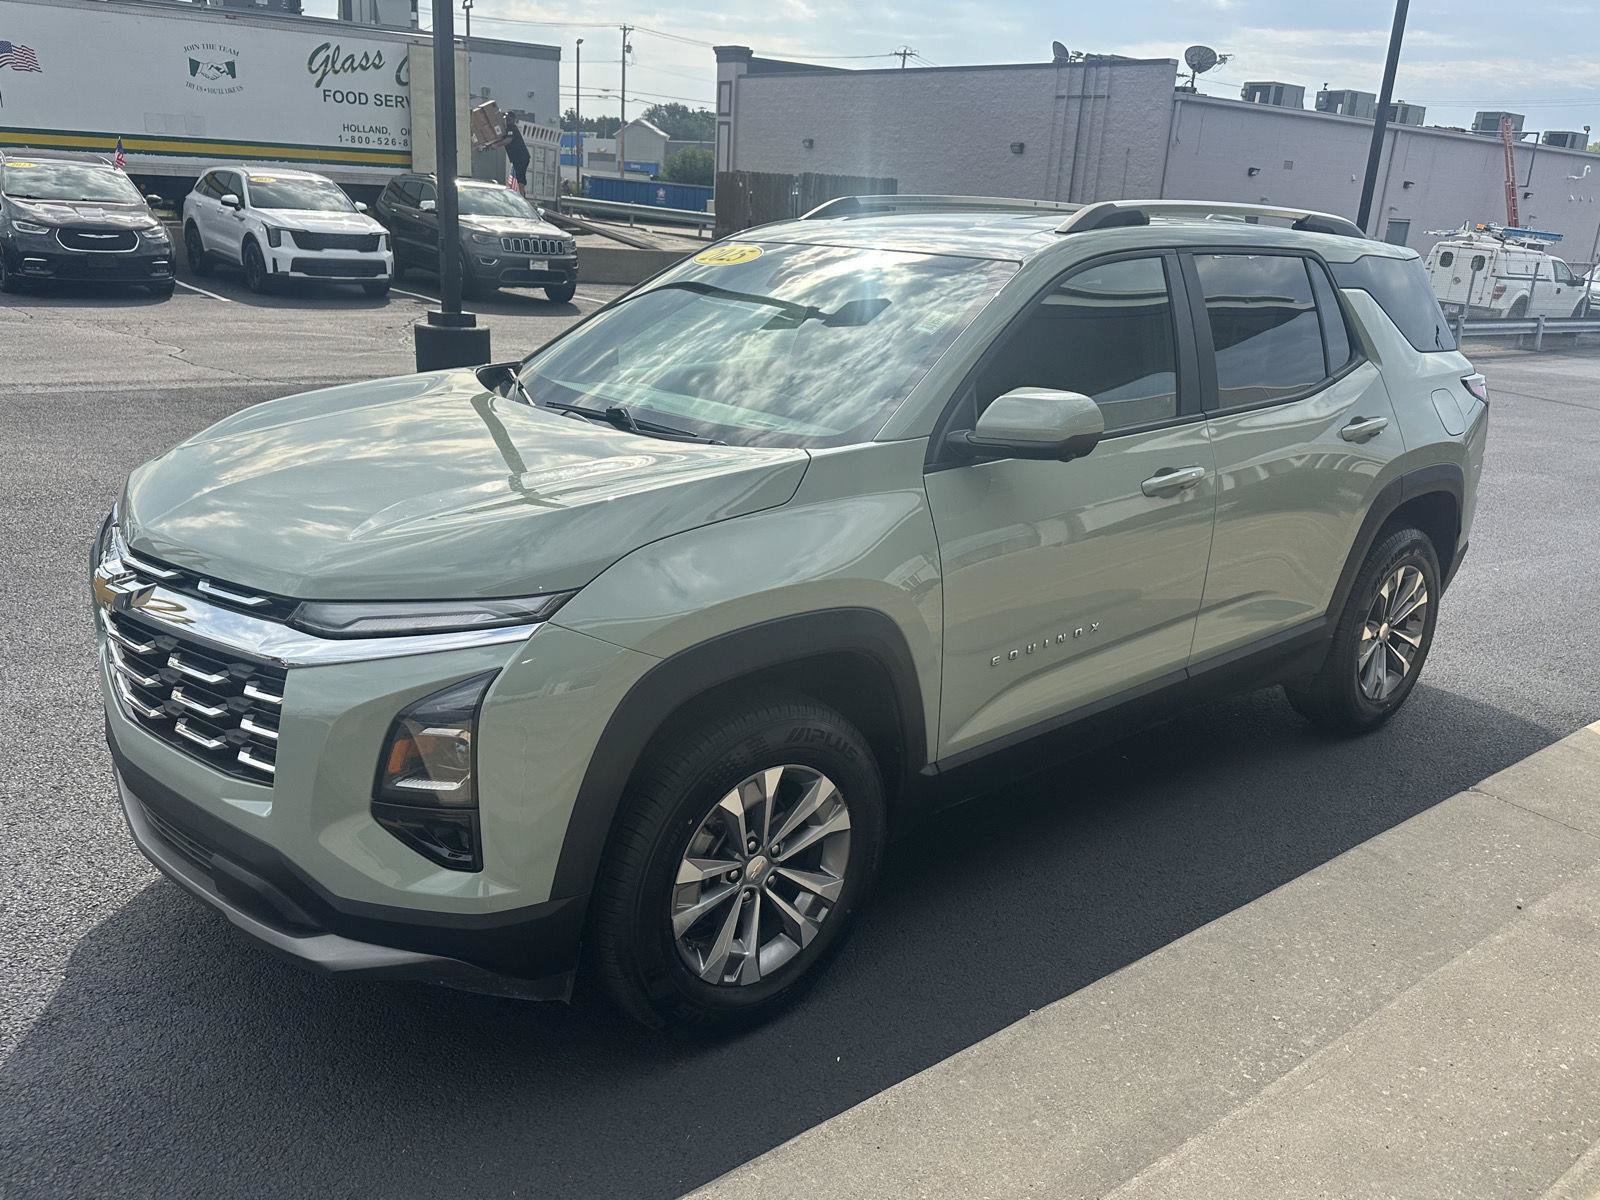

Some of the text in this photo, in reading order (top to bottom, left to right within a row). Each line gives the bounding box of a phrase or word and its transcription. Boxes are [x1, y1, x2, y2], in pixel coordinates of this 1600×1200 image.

[184, 43, 200, 53] JOIN
[219, 45, 239, 56] TEAM
[308, 42, 385, 88] Glass
[323, 89, 368, 105] FOOD
[991, 621, 1099, 666] EQUINOX
